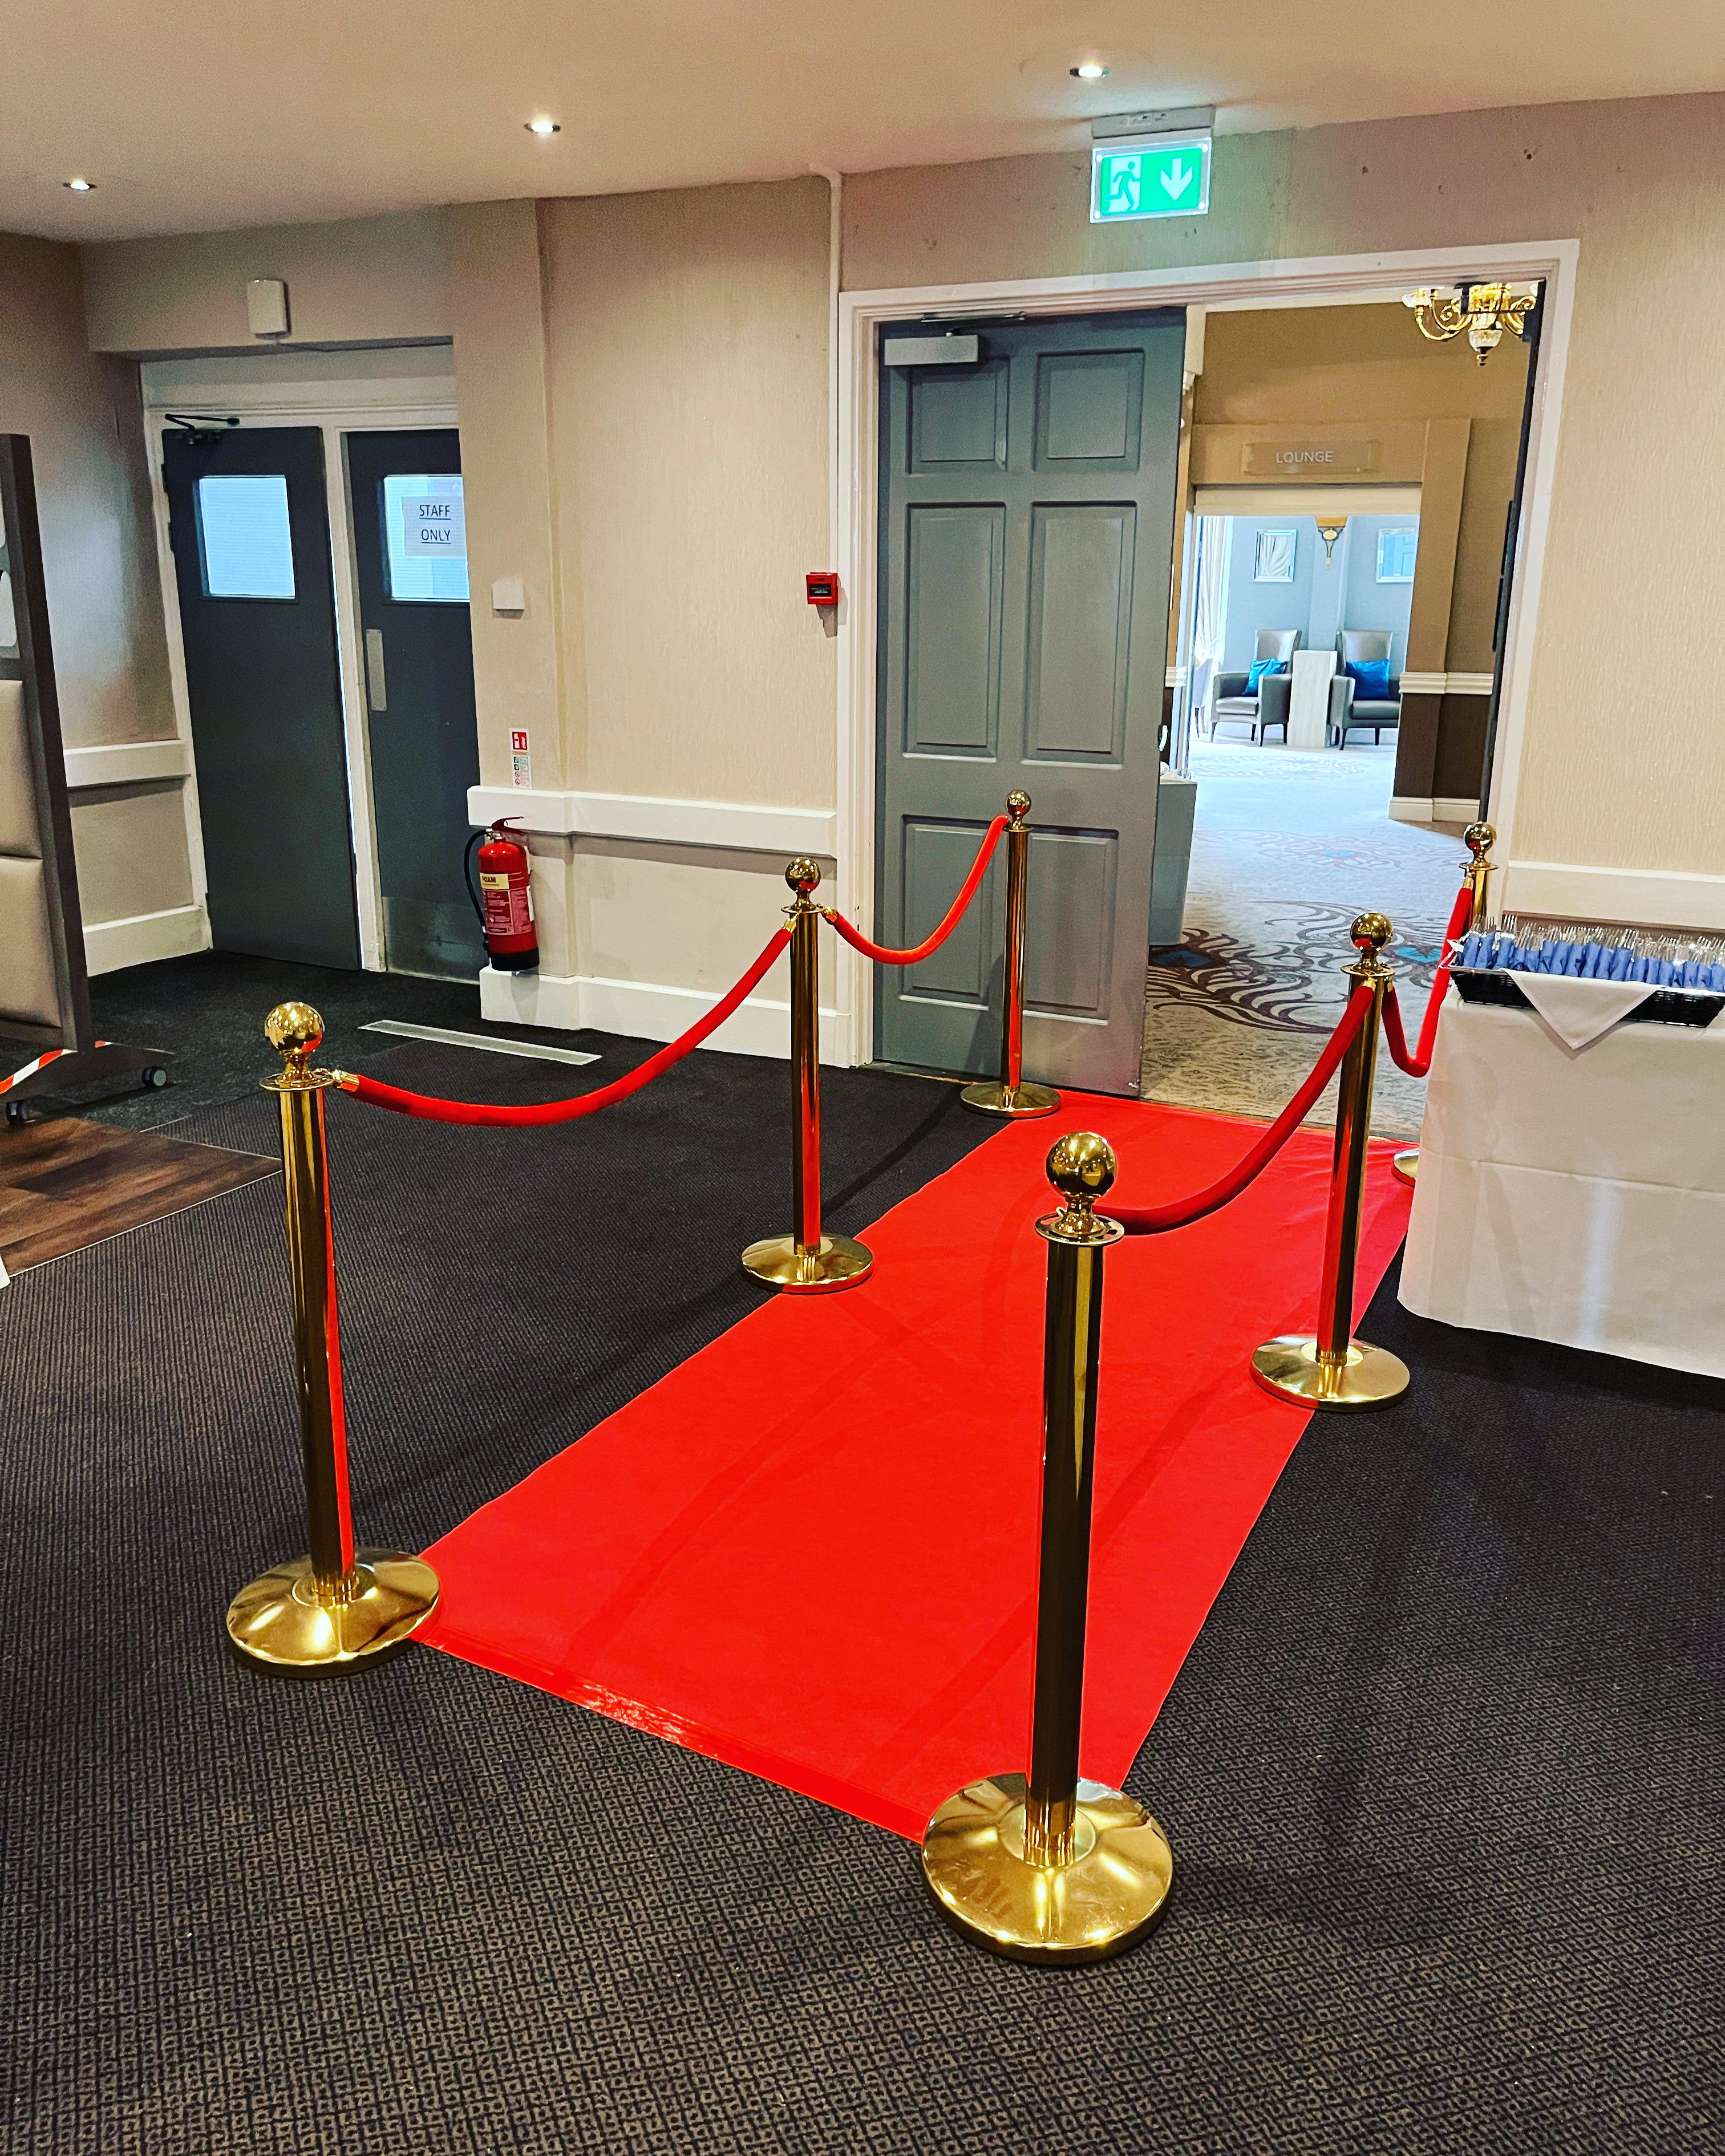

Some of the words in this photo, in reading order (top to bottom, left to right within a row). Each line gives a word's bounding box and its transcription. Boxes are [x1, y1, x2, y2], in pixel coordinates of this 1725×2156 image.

[1275, 451, 1334, 464] LOUNGE
[419, 504, 450, 517] STAFF
[421, 529, 451, 541] ONLY
